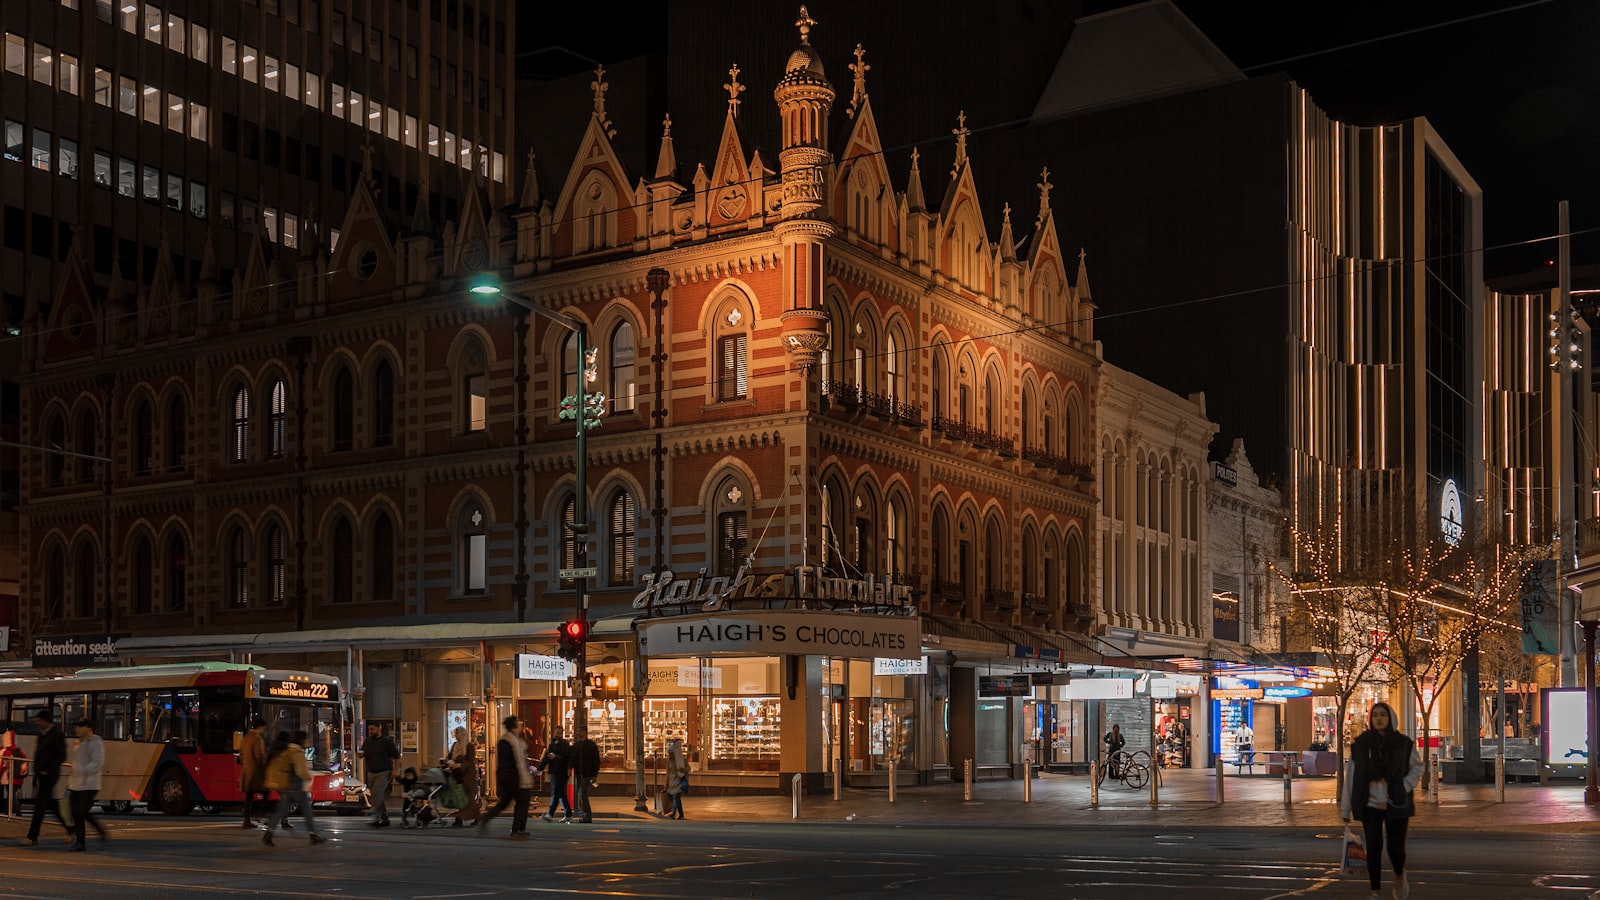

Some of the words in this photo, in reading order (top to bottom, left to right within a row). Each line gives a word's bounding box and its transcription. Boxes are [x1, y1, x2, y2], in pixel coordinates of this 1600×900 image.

[676, 624, 788, 644] HAIGH'S
[796, 625, 906, 649] CHOCOLATES
[36, 638, 87, 656] attention
[89, 637, 117, 655] seek
[528, 660, 566, 671] HAIGH'S
[281, 681, 298, 690] CITY
[310, 683, 329, 699] 222
